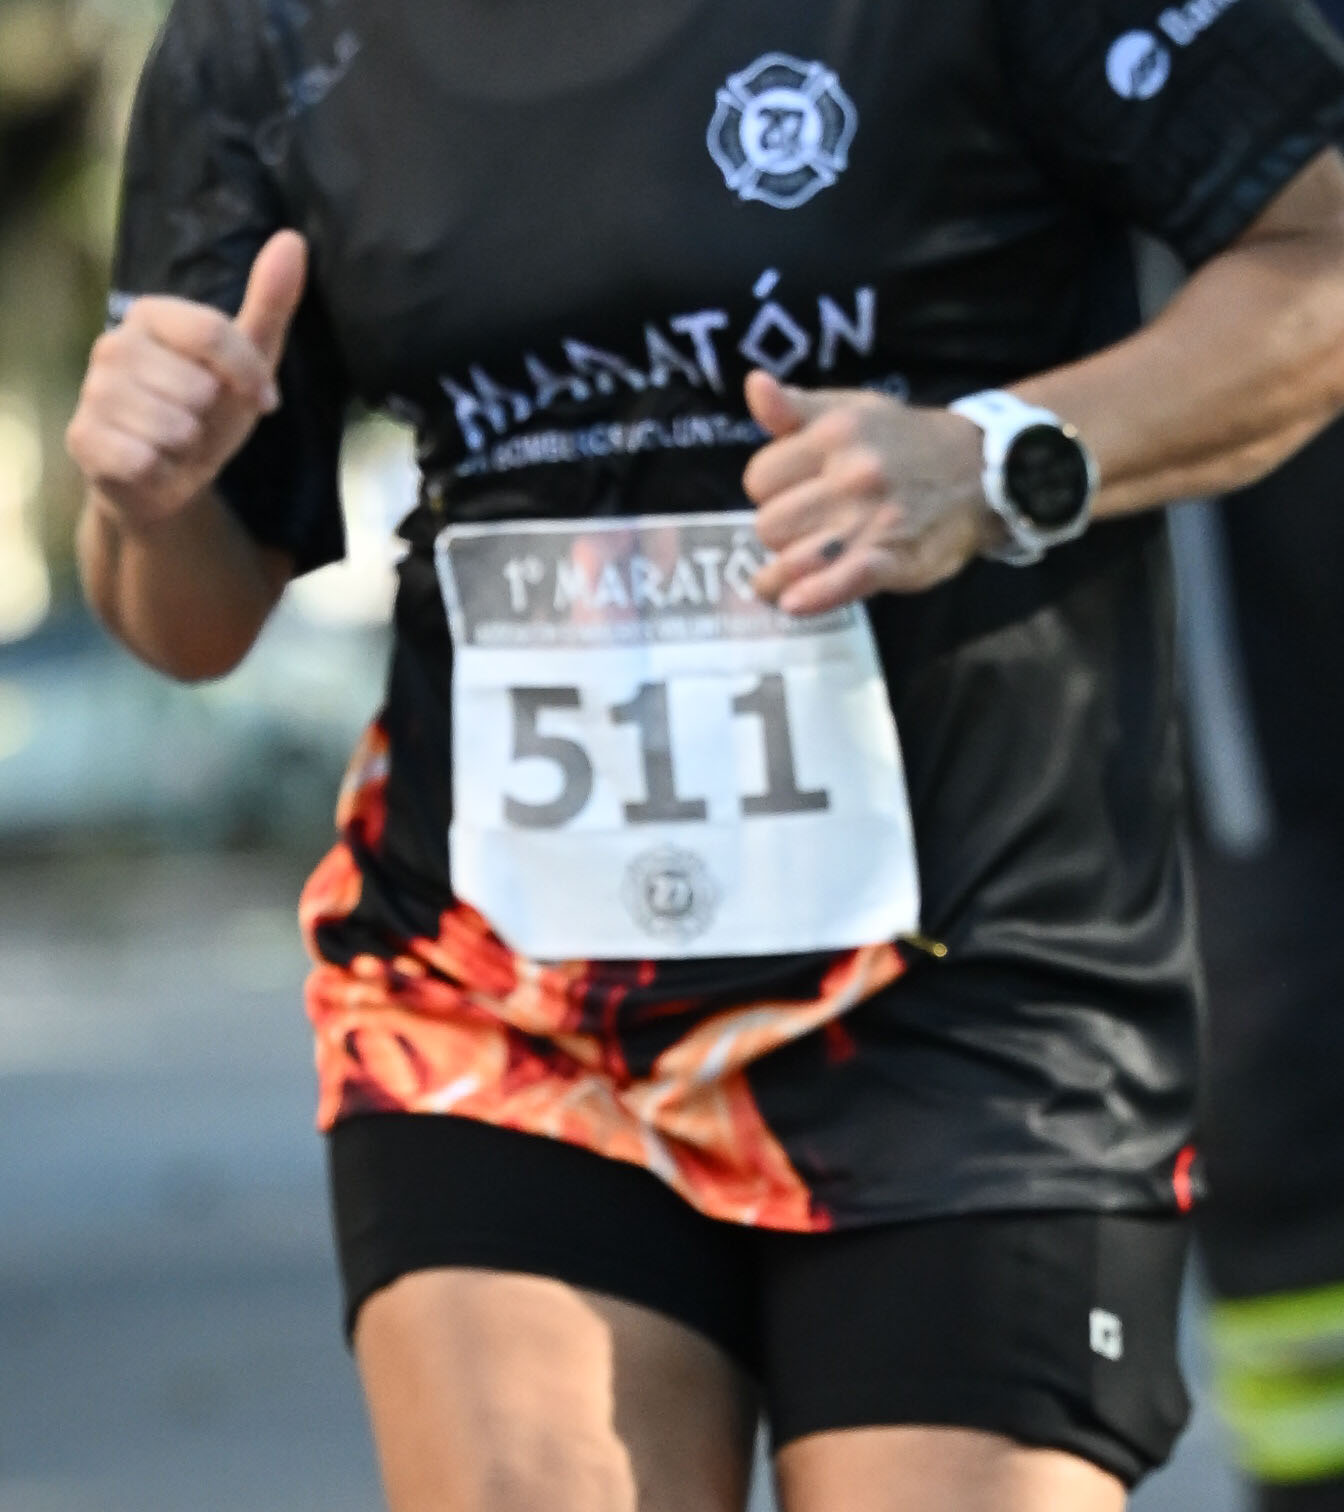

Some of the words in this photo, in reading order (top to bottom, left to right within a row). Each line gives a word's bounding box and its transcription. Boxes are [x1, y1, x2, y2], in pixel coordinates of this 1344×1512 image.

[441, 269, 877, 451] MARATÓN
[554, 530, 777, 610] MARATÓ
[502, 672, 829, 830] 511
